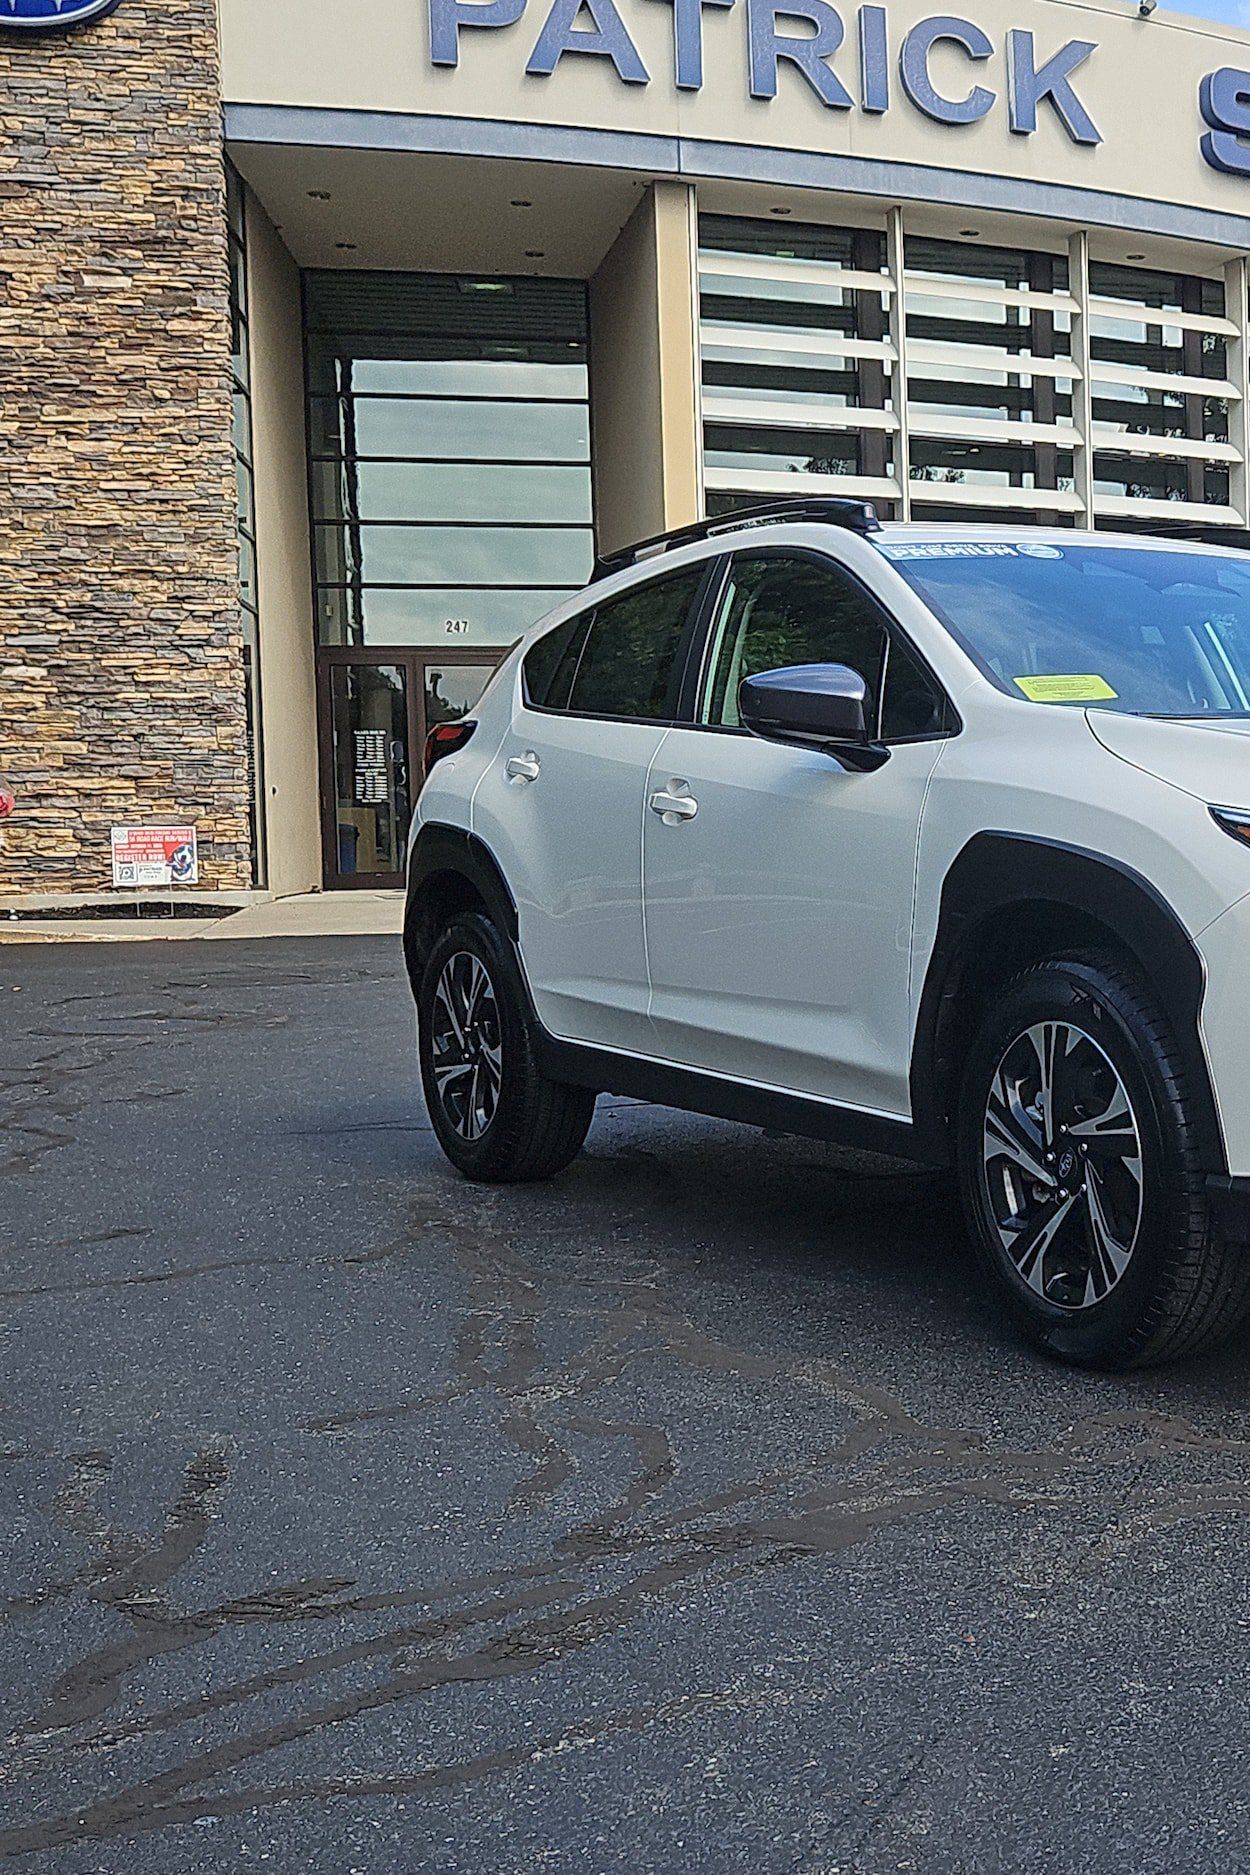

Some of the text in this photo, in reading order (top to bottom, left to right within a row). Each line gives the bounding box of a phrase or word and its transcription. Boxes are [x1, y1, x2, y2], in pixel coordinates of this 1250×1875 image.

[430, 0, 1104, 145] PATRICK
[889, 546, 1019, 557] PREMIUM
[445, 621, 469, 633] 247
